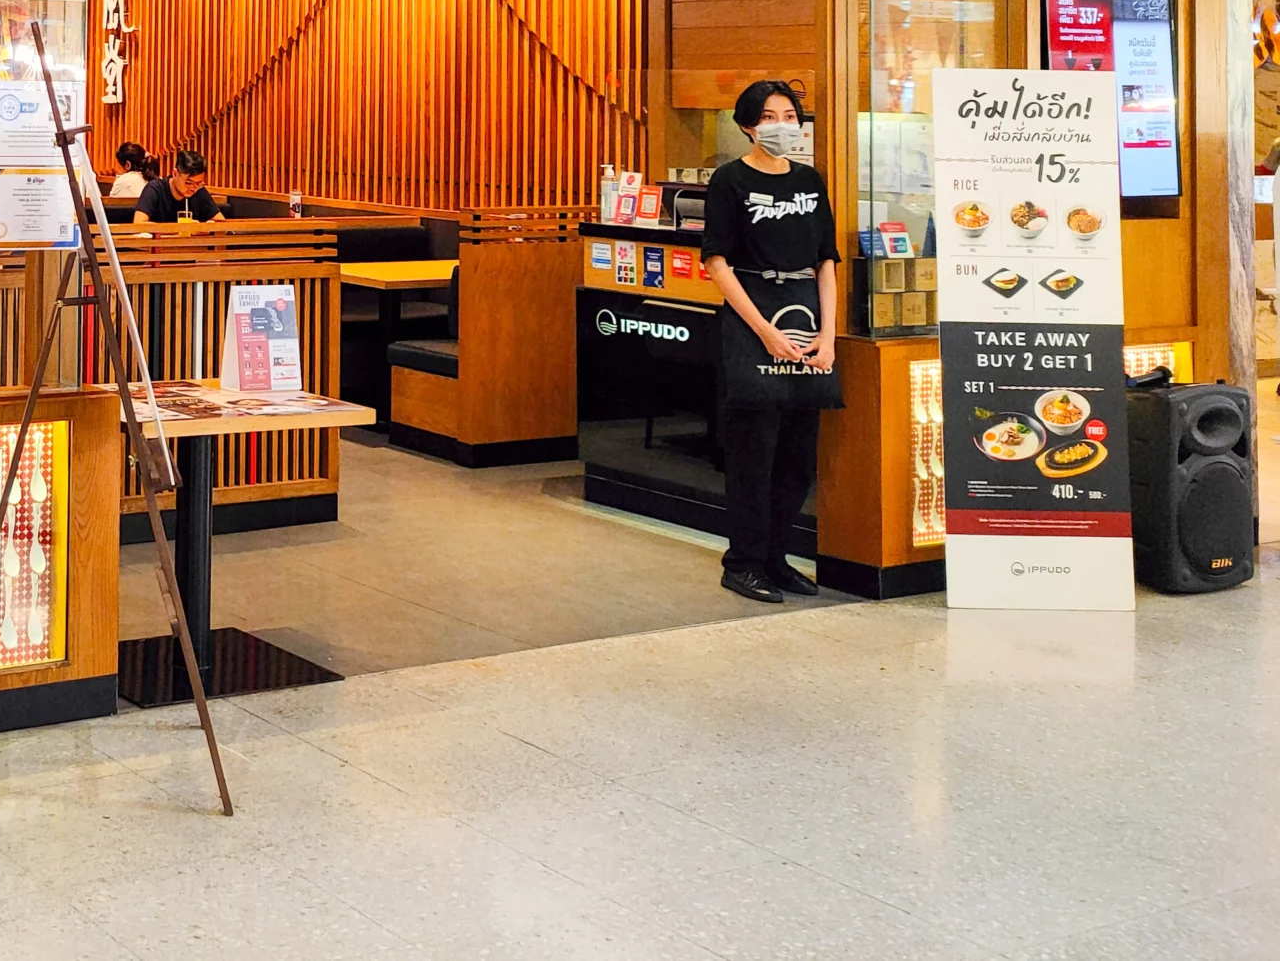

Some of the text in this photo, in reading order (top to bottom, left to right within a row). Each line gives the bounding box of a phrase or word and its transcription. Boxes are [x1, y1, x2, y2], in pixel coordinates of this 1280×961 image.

[958, 77, 1092, 129] คุ้มได้อีก!
[1034, 153, 1081, 184] 15%
[953, 179, 979, 190] RICE
[956, 264, 978, 275] BUN
[620, 318, 690, 342] IPPUDO
[974, 331, 1090, 348] TAKE AWAY
[977, 352, 1093, 372] BUY 2 GET 1
[756, 365, 833, 375] THAILAND
[964, 381, 995, 393] SET 1
[1087, 426, 1104, 435] FREE
[1051, 484, 1084, 499] 410.-
[1028, 566, 1071, 574] IPPUDO
